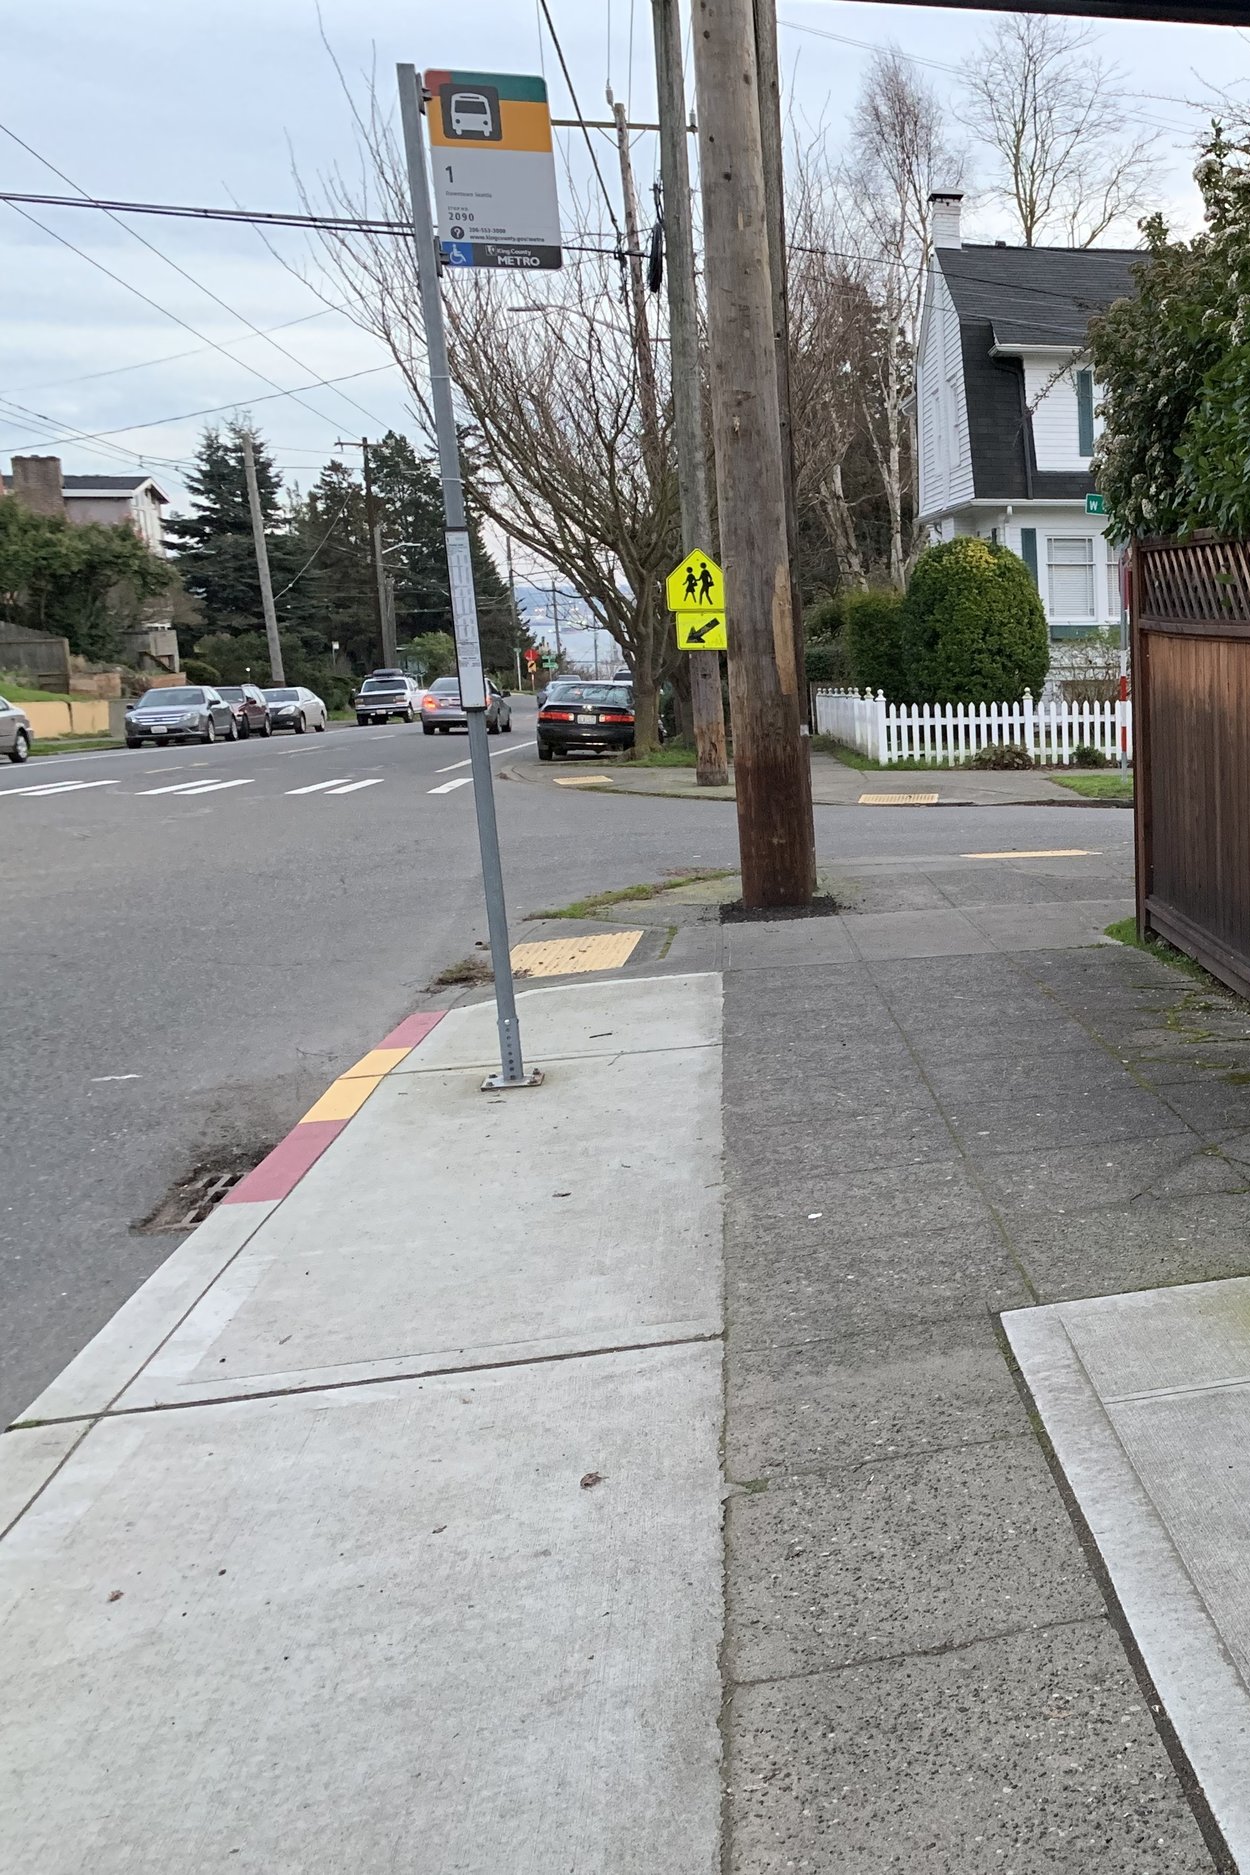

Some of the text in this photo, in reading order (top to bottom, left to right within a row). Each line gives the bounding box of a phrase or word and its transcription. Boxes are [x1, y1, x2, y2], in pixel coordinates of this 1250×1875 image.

[445, 165, 454, 183] 1
[448, 211, 475, 221] 2090
[497, 247, 532, 256] King County
[497, 255, 540, 266] METRO
[1089, 499, 1098, 511] W
